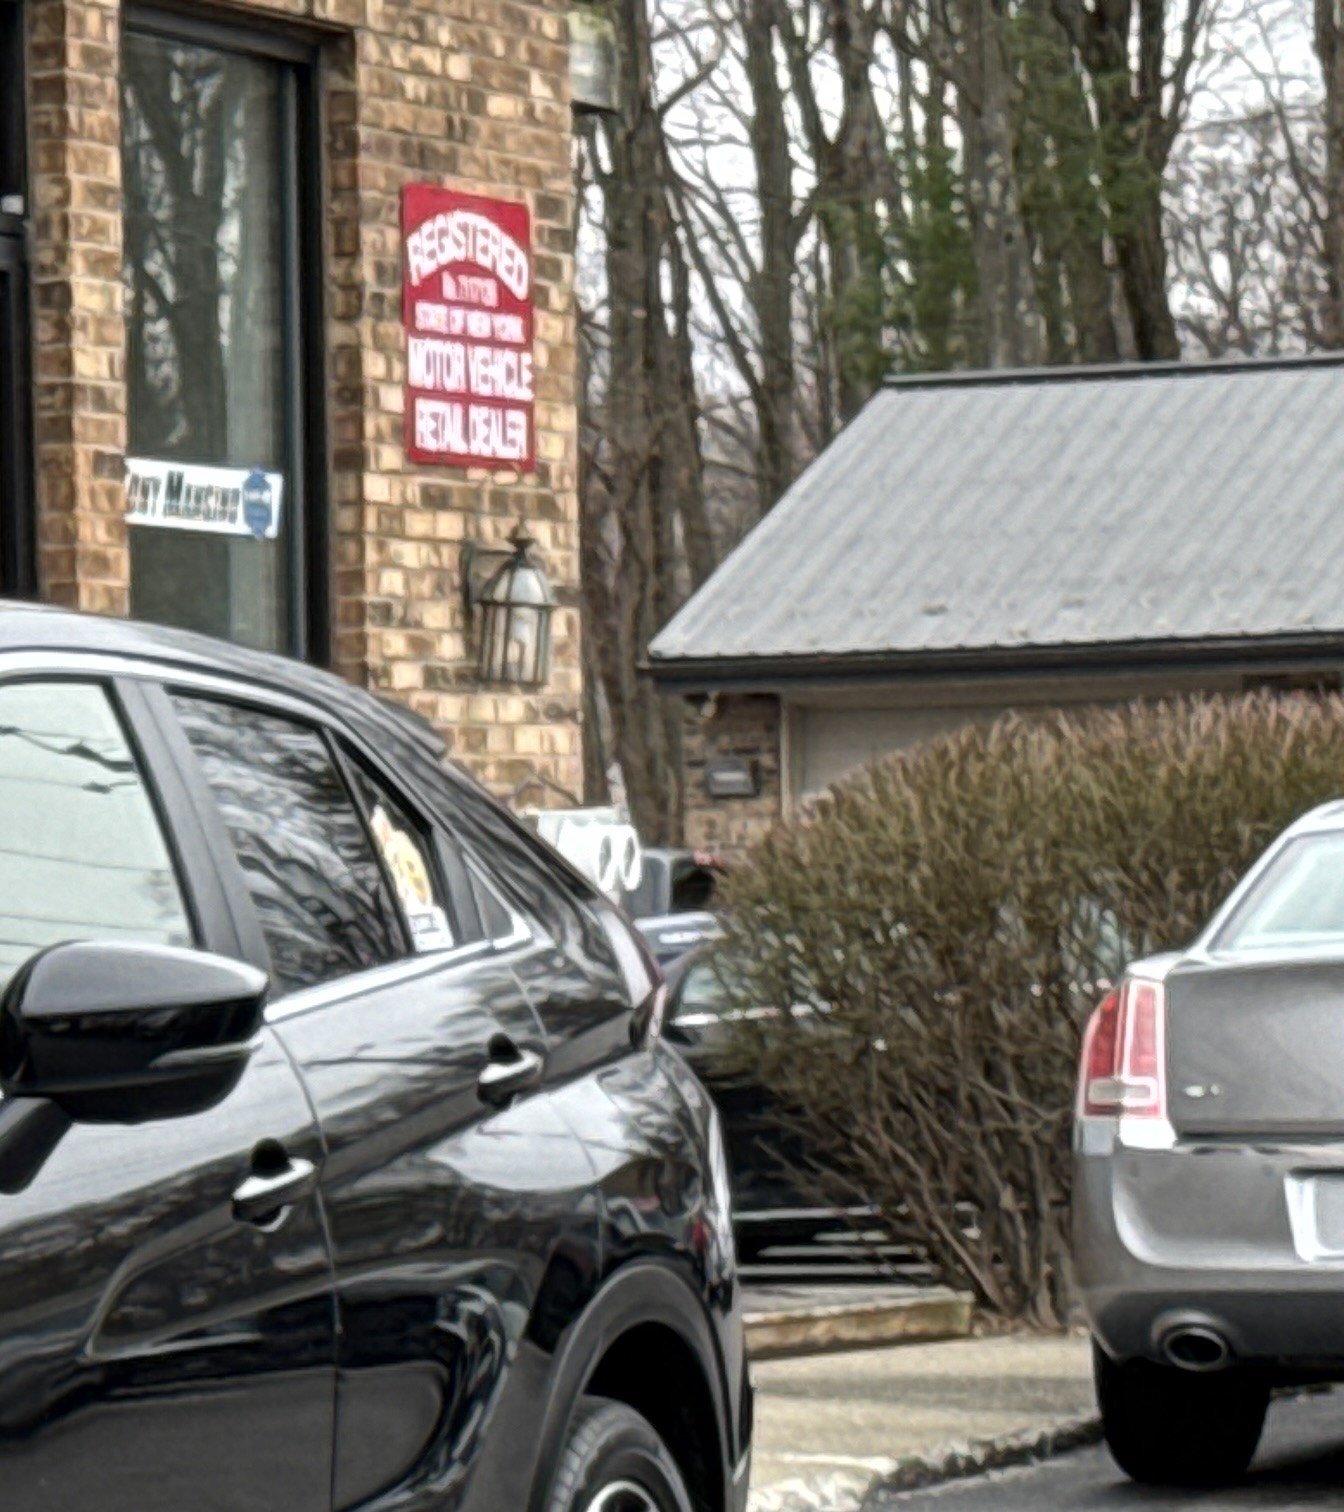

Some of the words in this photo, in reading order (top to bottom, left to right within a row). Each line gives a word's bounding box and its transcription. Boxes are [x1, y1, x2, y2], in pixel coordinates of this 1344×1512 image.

[406, 208, 529, 302] REGISTERED
[408, 336, 467, 393] MOTOR
[466, 343, 534, 401] VEHICLE
[414, 397, 468, 455] RETAIL
[468, 403, 527, 461] DEALER
